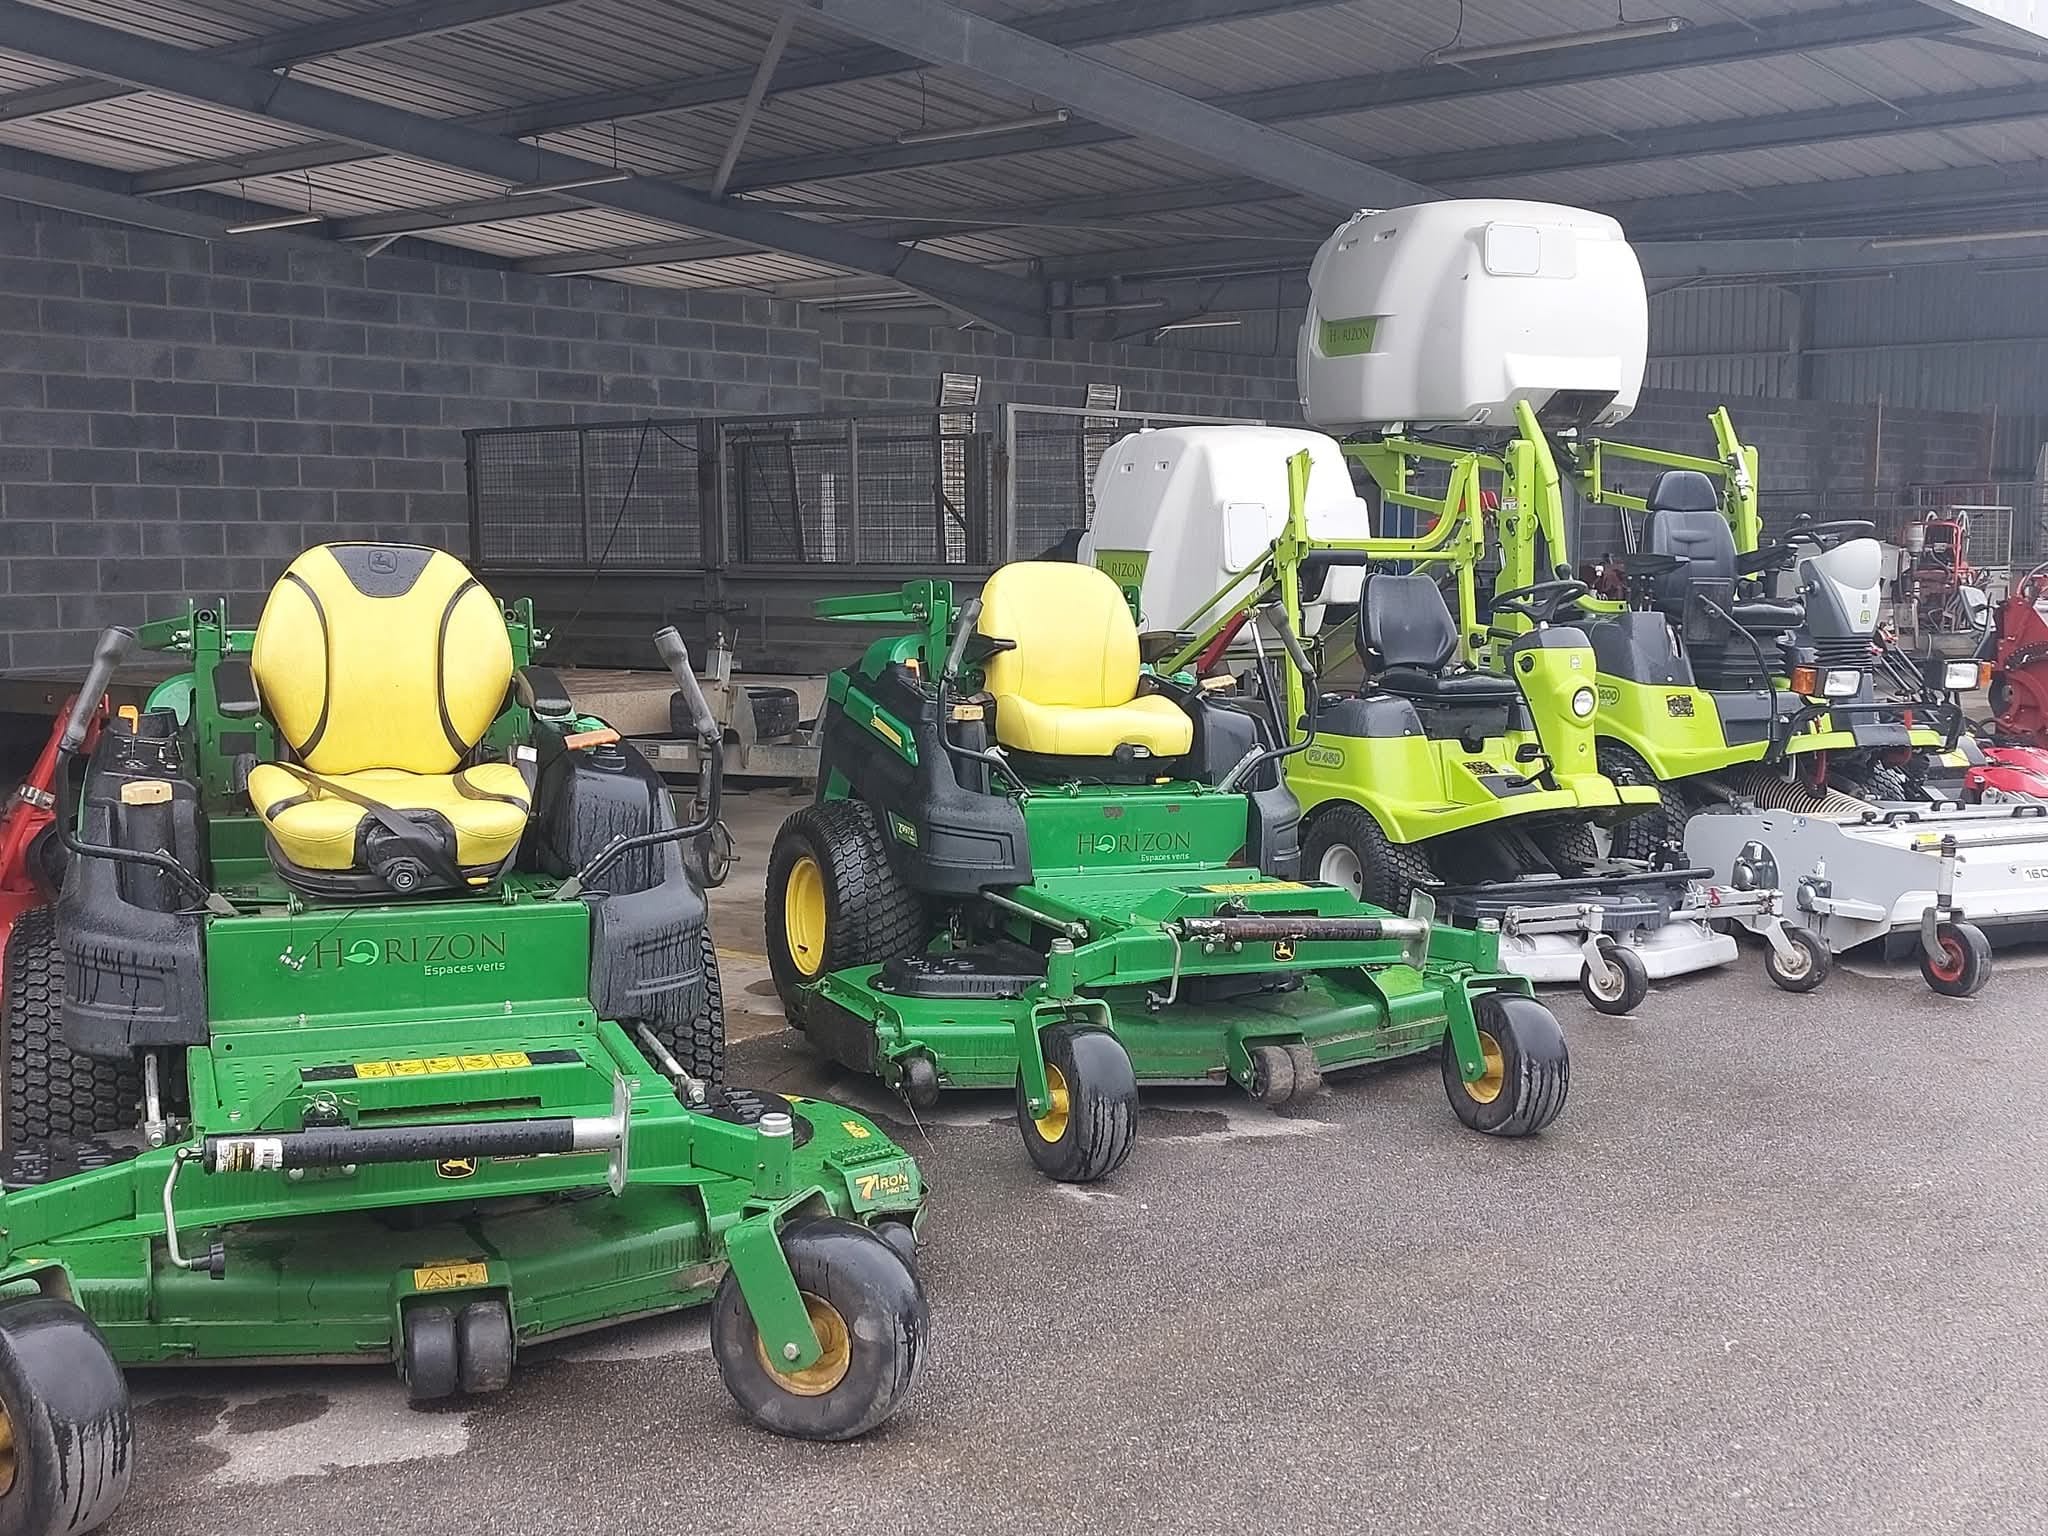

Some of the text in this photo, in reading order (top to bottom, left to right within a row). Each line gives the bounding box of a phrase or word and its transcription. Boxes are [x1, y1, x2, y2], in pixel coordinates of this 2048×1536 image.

[1329, 328, 1369, 344] HRIZON
[1096, 560, 1144, 577] HRIZON
[1078, 831, 1190, 854] HORIZON
[1141, 853, 1189, 863] Espaces verts
[315, 931, 505, 968] HORIZON
[424, 961, 506, 977] Espaces verts
